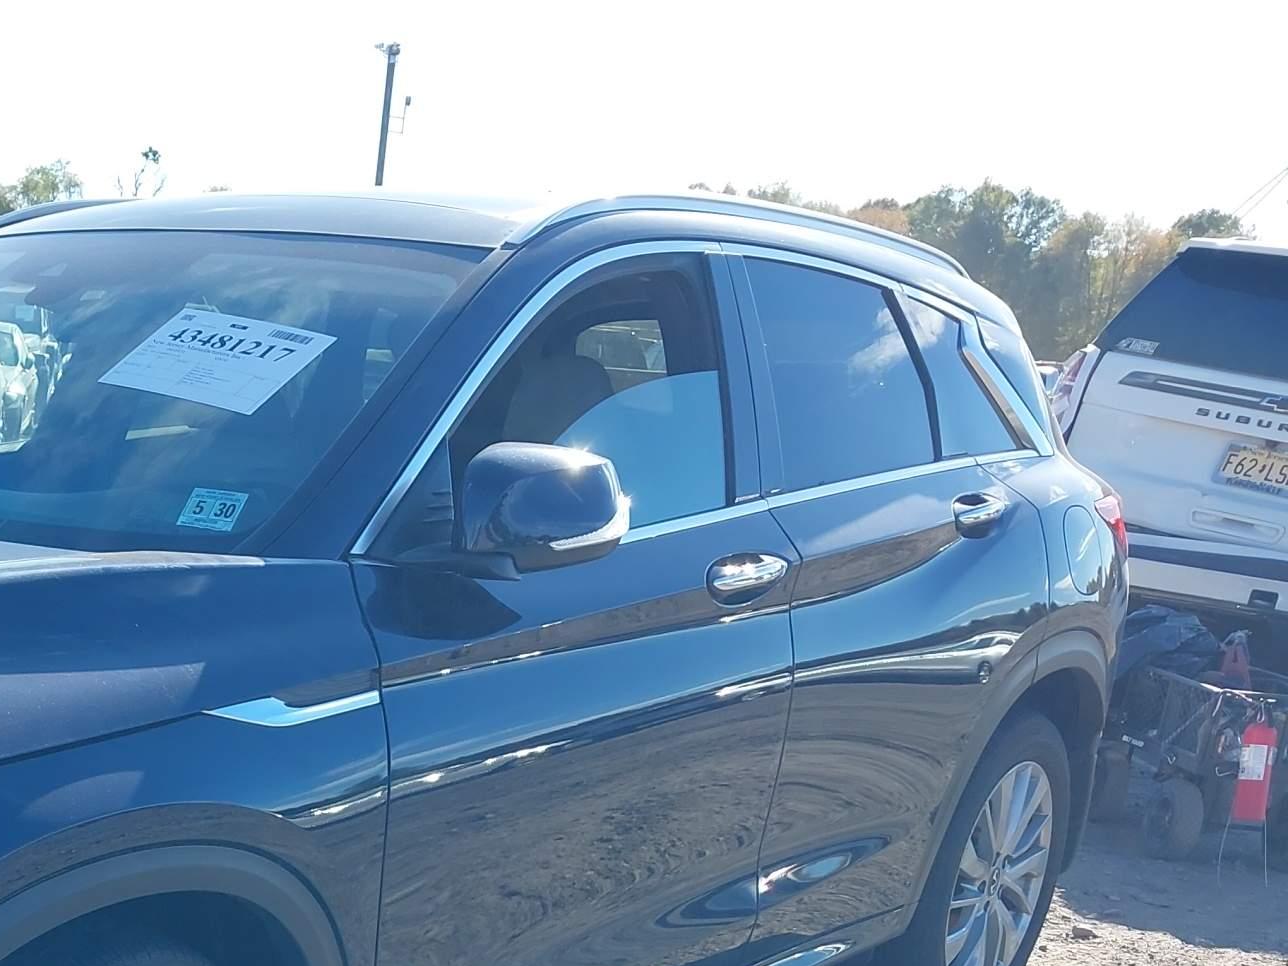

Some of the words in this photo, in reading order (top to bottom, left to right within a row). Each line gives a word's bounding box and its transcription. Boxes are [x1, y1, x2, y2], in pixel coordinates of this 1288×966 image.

[168, 327, 297, 362] 43481217
[192, 500, 207, 515] 5
[214, 502, 237, 519] 30
